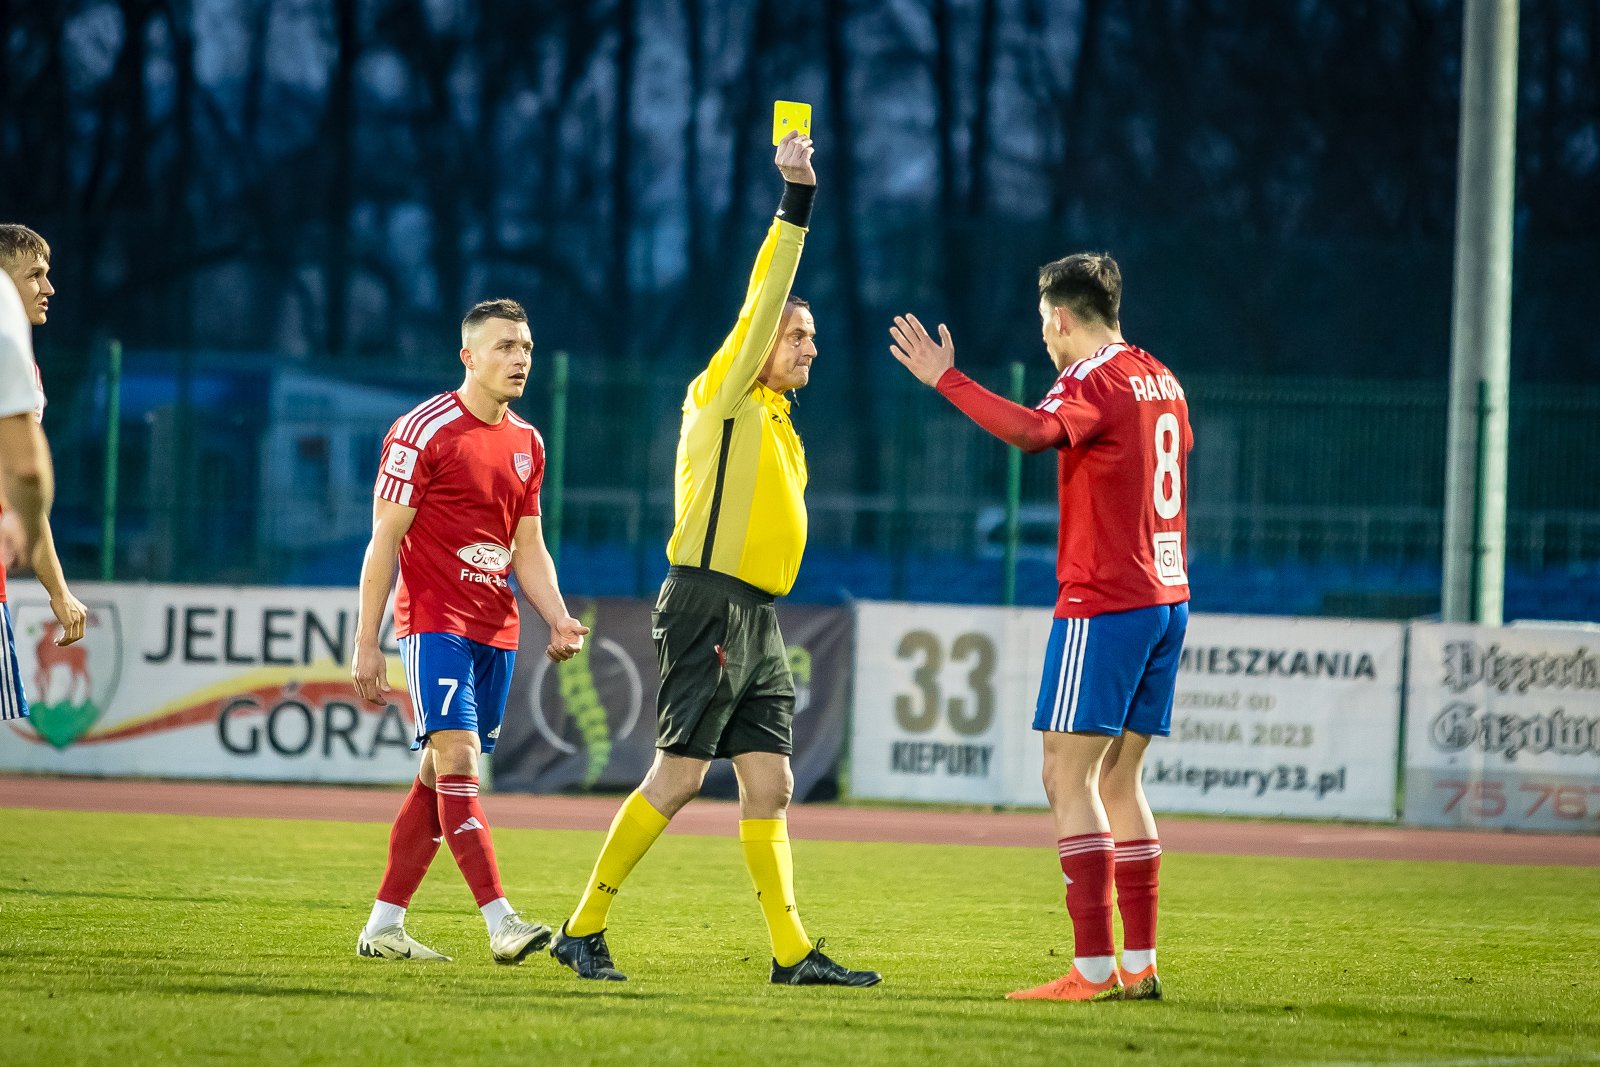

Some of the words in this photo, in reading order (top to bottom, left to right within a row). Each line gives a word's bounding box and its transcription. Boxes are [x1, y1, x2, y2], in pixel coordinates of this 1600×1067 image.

[1154, 413, 1181, 519] 8
[472, 546, 502, 565] Ford
[143, 606, 400, 667] JELEN
[437, 678, 459, 716] 7
[895, 630, 997, 737] 33
[217, 682, 414, 759] GÓRA
[1251, 722, 1314, 748] 2023
[890, 741, 994, 778] KIEPURY
[1434, 778, 1508, 819] 75
